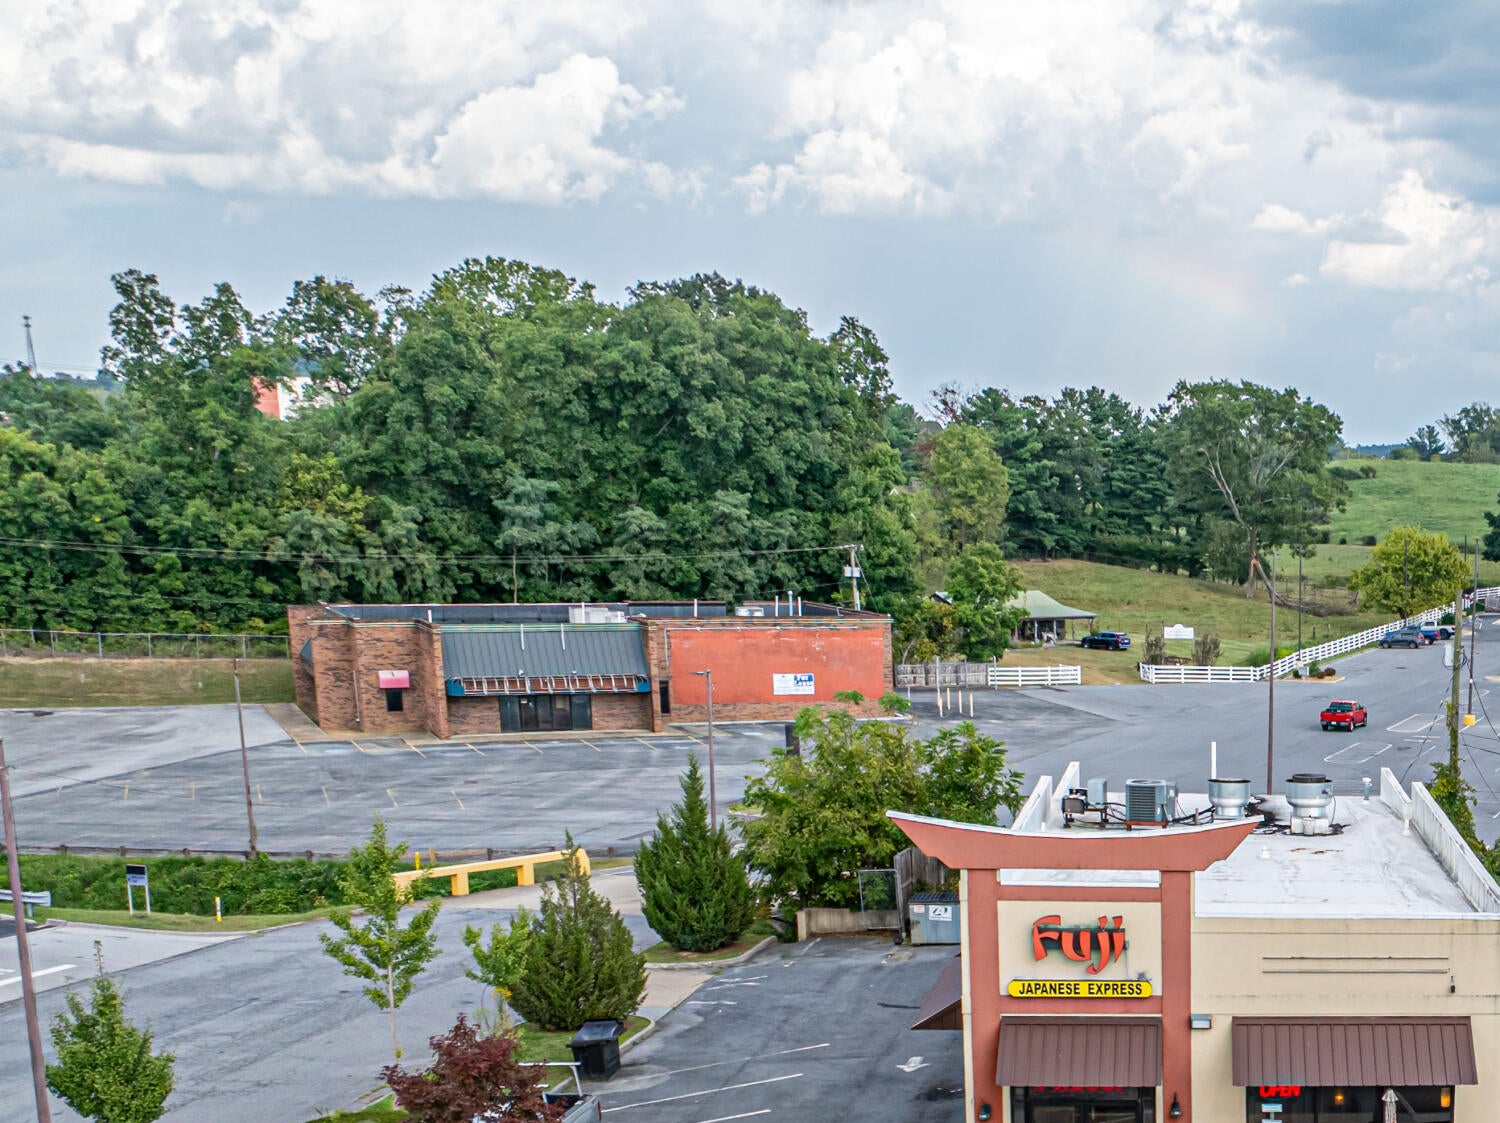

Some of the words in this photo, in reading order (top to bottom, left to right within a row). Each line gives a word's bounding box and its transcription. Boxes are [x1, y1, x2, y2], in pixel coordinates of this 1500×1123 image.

[1032, 914, 1125, 975] Fuji
[1018, 982, 1081, 995] JAPANESE
[1088, 983, 1143, 996] EXPRESS
[1259, 1085, 1301, 1098] OPEN
